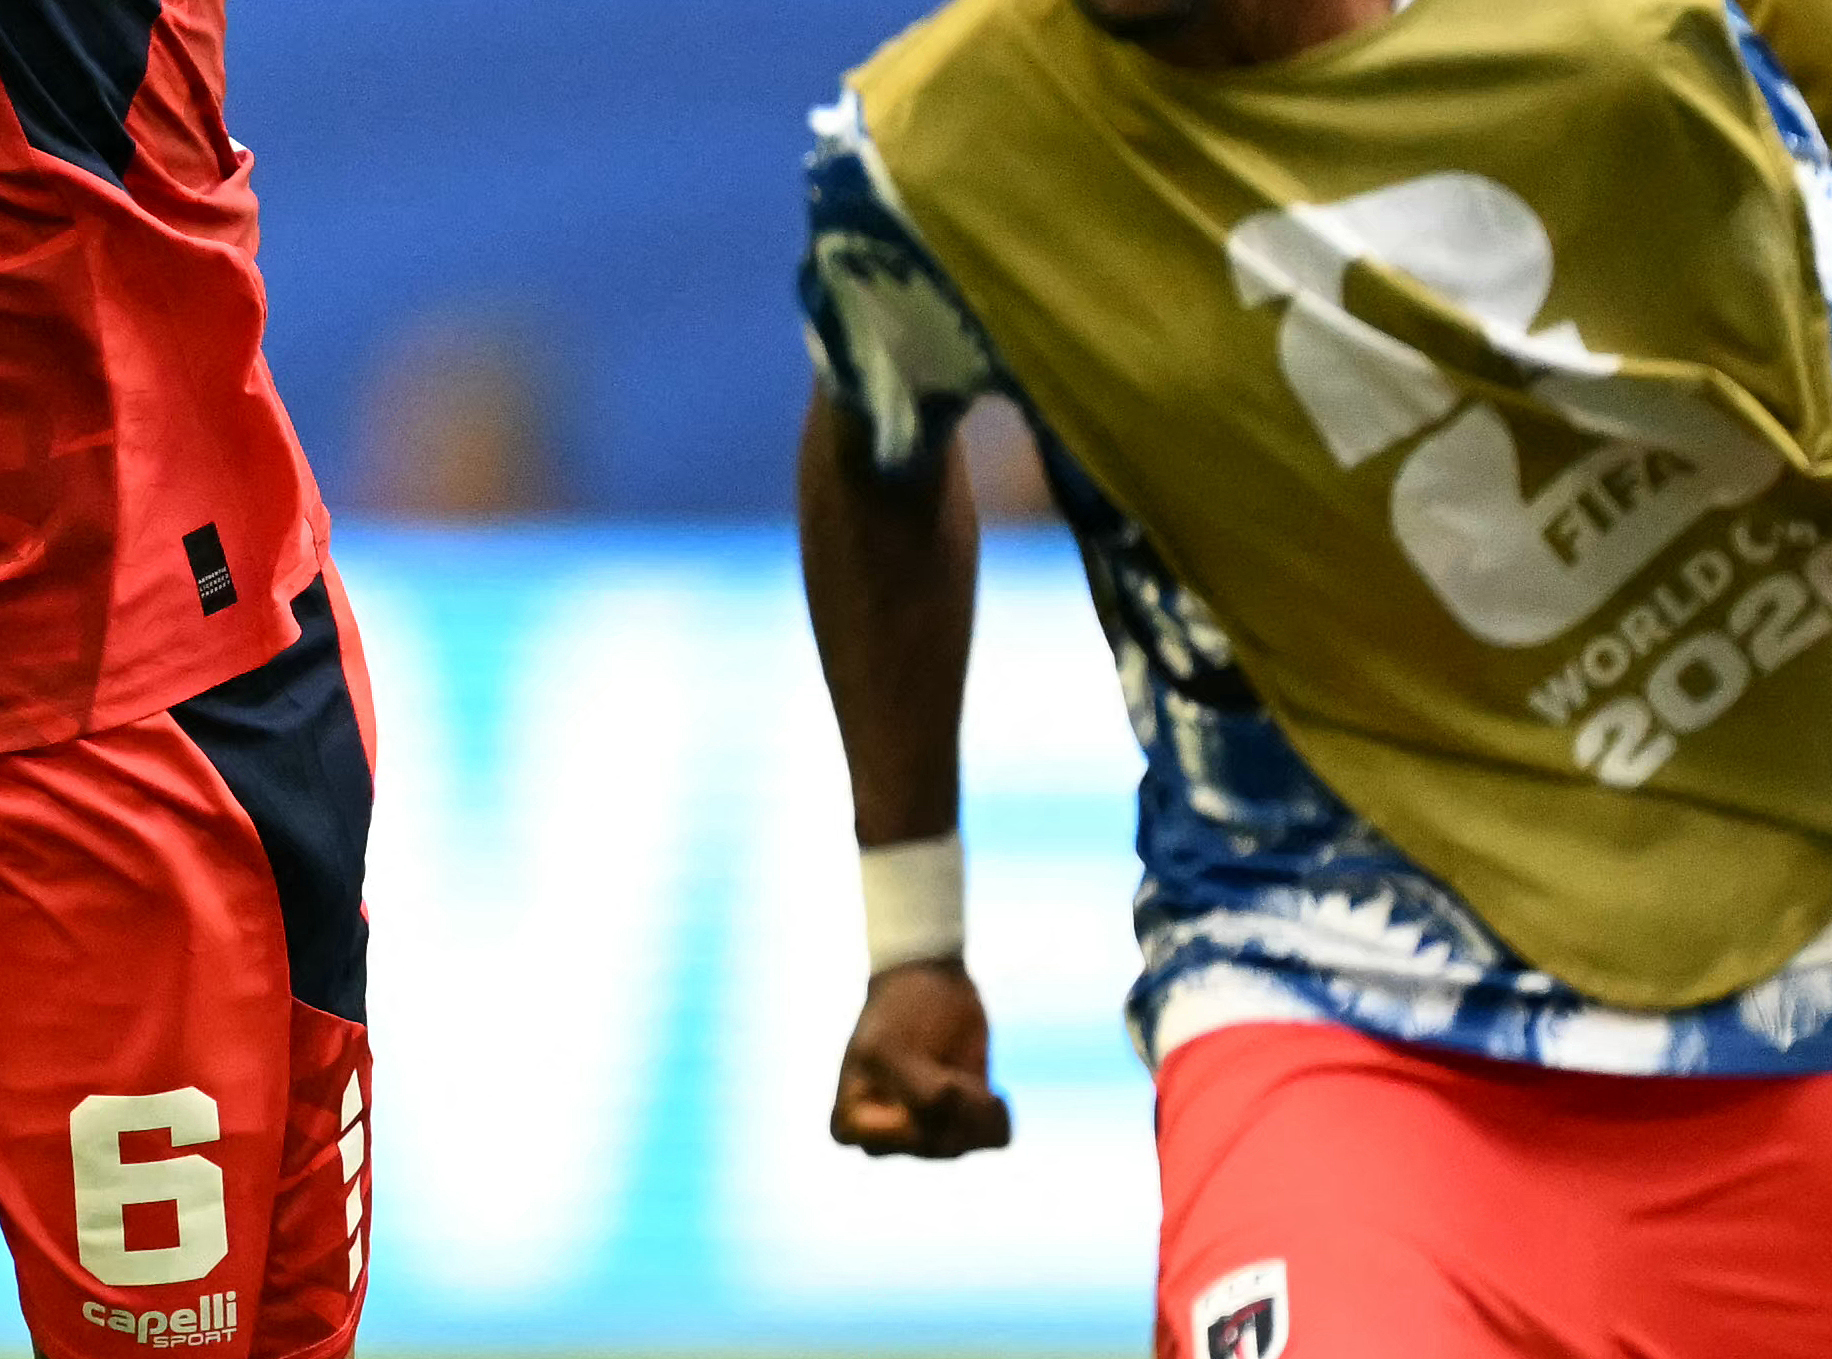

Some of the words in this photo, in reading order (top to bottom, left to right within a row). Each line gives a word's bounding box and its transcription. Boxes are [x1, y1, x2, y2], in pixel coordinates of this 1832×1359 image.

[1541, 448, 1700, 567] FIFA
[1527, 548, 1735, 725] WORLD
[69, 1085, 229, 1287] 6
[82, 1291, 237, 1344] capelli
[152, 1328, 237, 1349] SPORT
